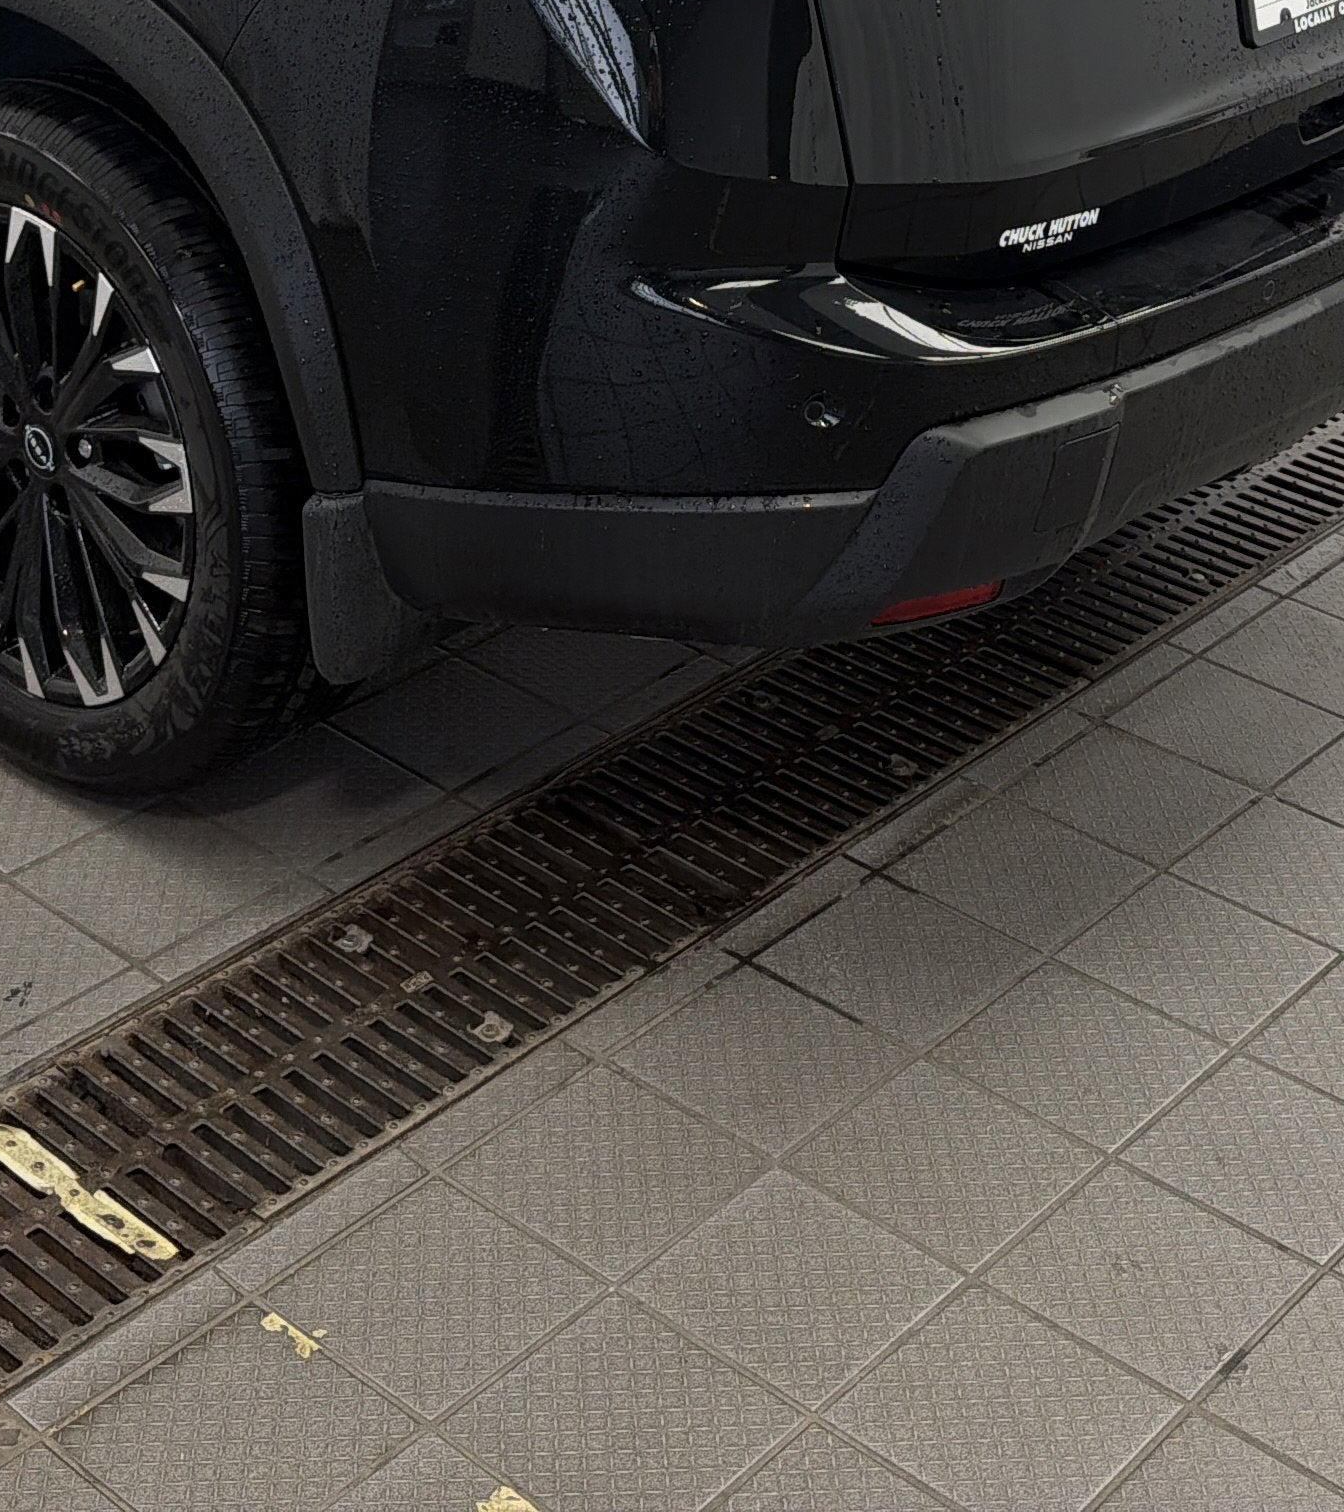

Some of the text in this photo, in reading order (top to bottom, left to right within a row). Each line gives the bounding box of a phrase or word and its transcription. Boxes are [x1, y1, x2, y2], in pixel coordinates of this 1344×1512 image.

[1294, 4, 1336, 33] LOCALLY
[999, 207, 1100, 248] CHUCK HUTTON
[1022, 231, 1073, 253] NISSAN
